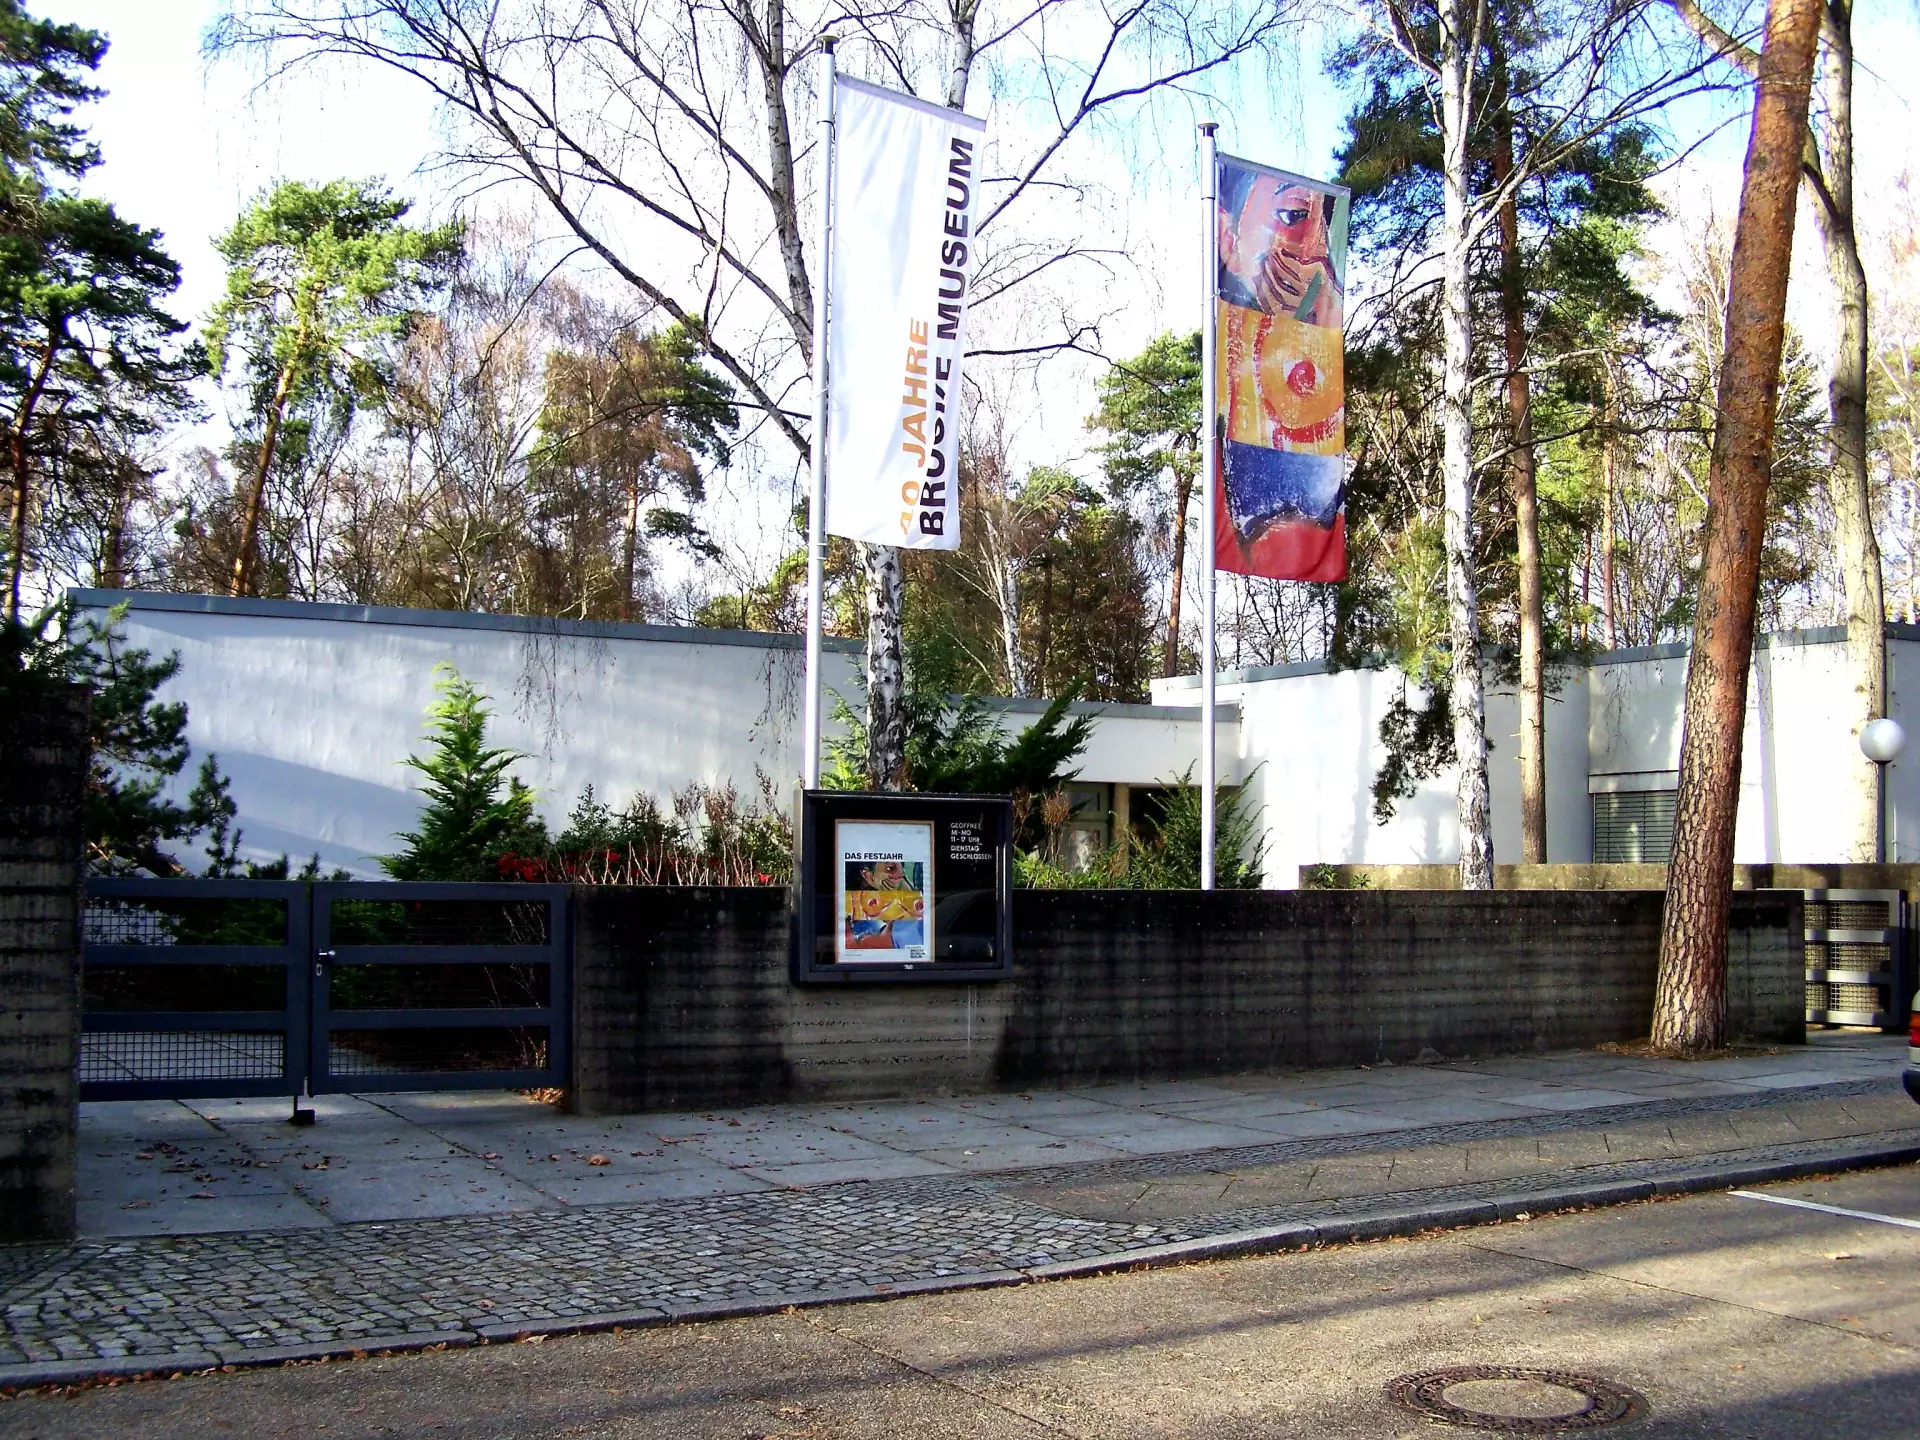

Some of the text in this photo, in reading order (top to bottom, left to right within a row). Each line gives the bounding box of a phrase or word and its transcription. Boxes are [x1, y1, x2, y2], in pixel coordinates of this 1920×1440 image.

[936, 137, 973, 341] MUSEUM
[900, 317, 929, 536] 40 JAHRE
[844, 852, 904, 860] DAS FESTJAHR
